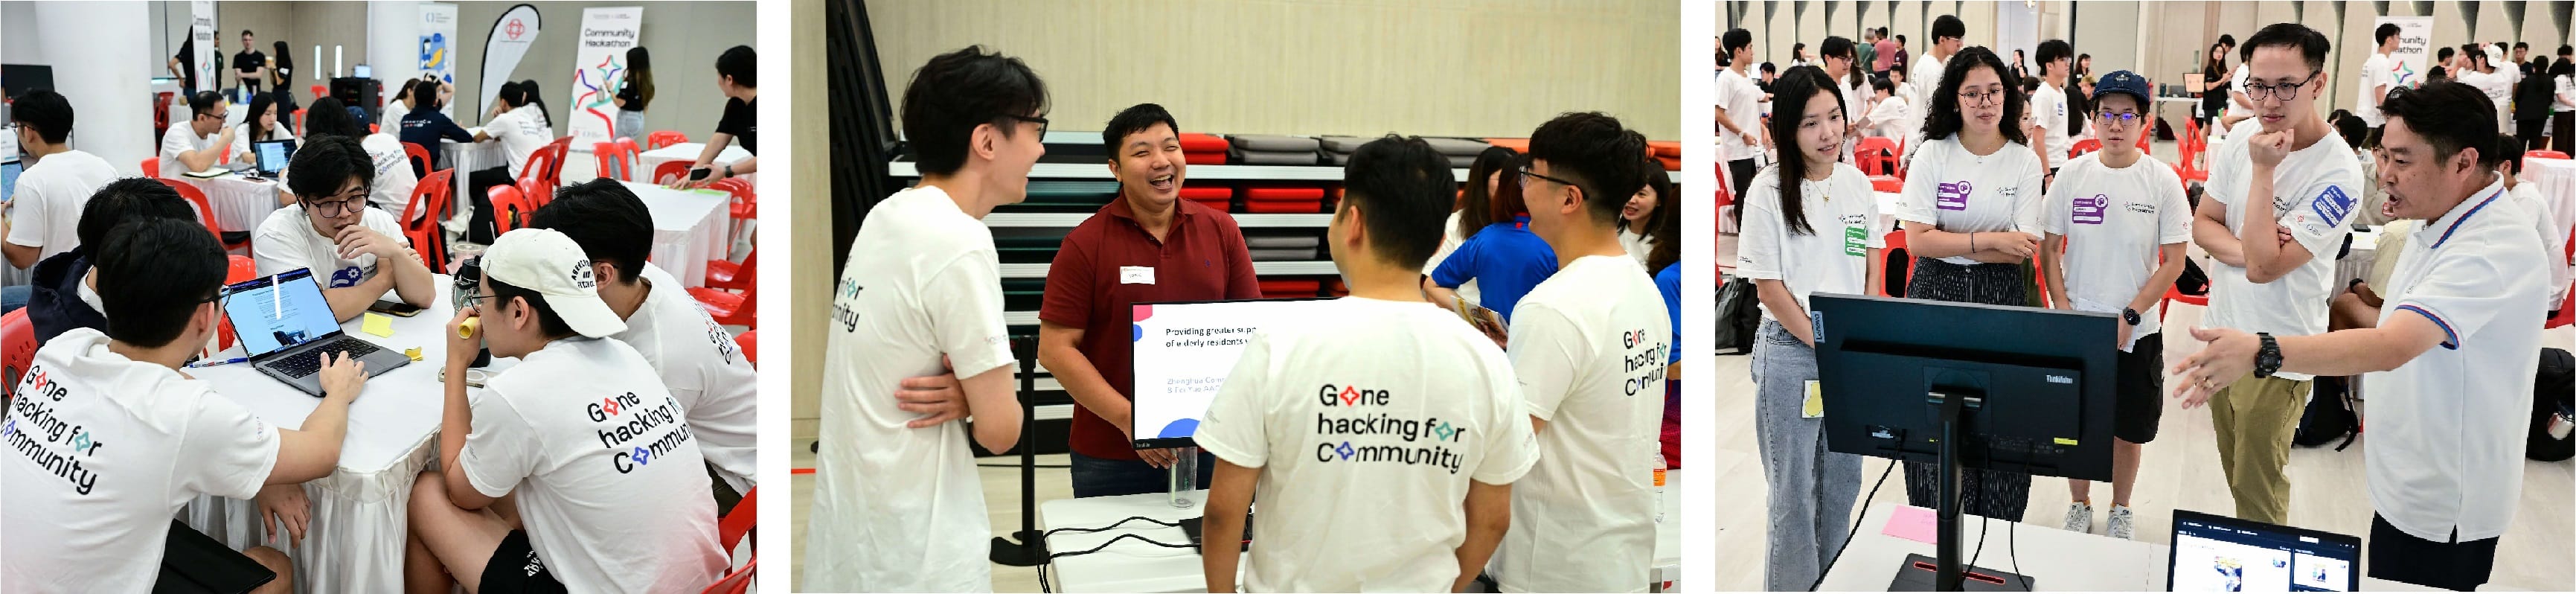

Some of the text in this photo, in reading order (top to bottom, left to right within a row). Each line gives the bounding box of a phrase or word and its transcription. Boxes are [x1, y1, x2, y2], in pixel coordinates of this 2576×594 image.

[585, 28, 635, 39] Community
[585, 39, 630, 48] Hackathon
[1166, 328, 1205, 336] Providing
[1206, 328, 1235, 336] greater
[1814, 313, 1823, 340] Lenovo
[1176, 339, 1205, 348] ederly
[26, 365, 68, 402] Gone
[1319, 384, 1390, 407] Gone
[13, 387, 103, 456] hacking for
[587, 392, 641, 423] Gone
[597, 404, 674, 449] hacking
[1318, 412, 1466, 443] hacking for
[614, 423, 691, 474] Commun
[1317, 441, 1464, 475] Community
